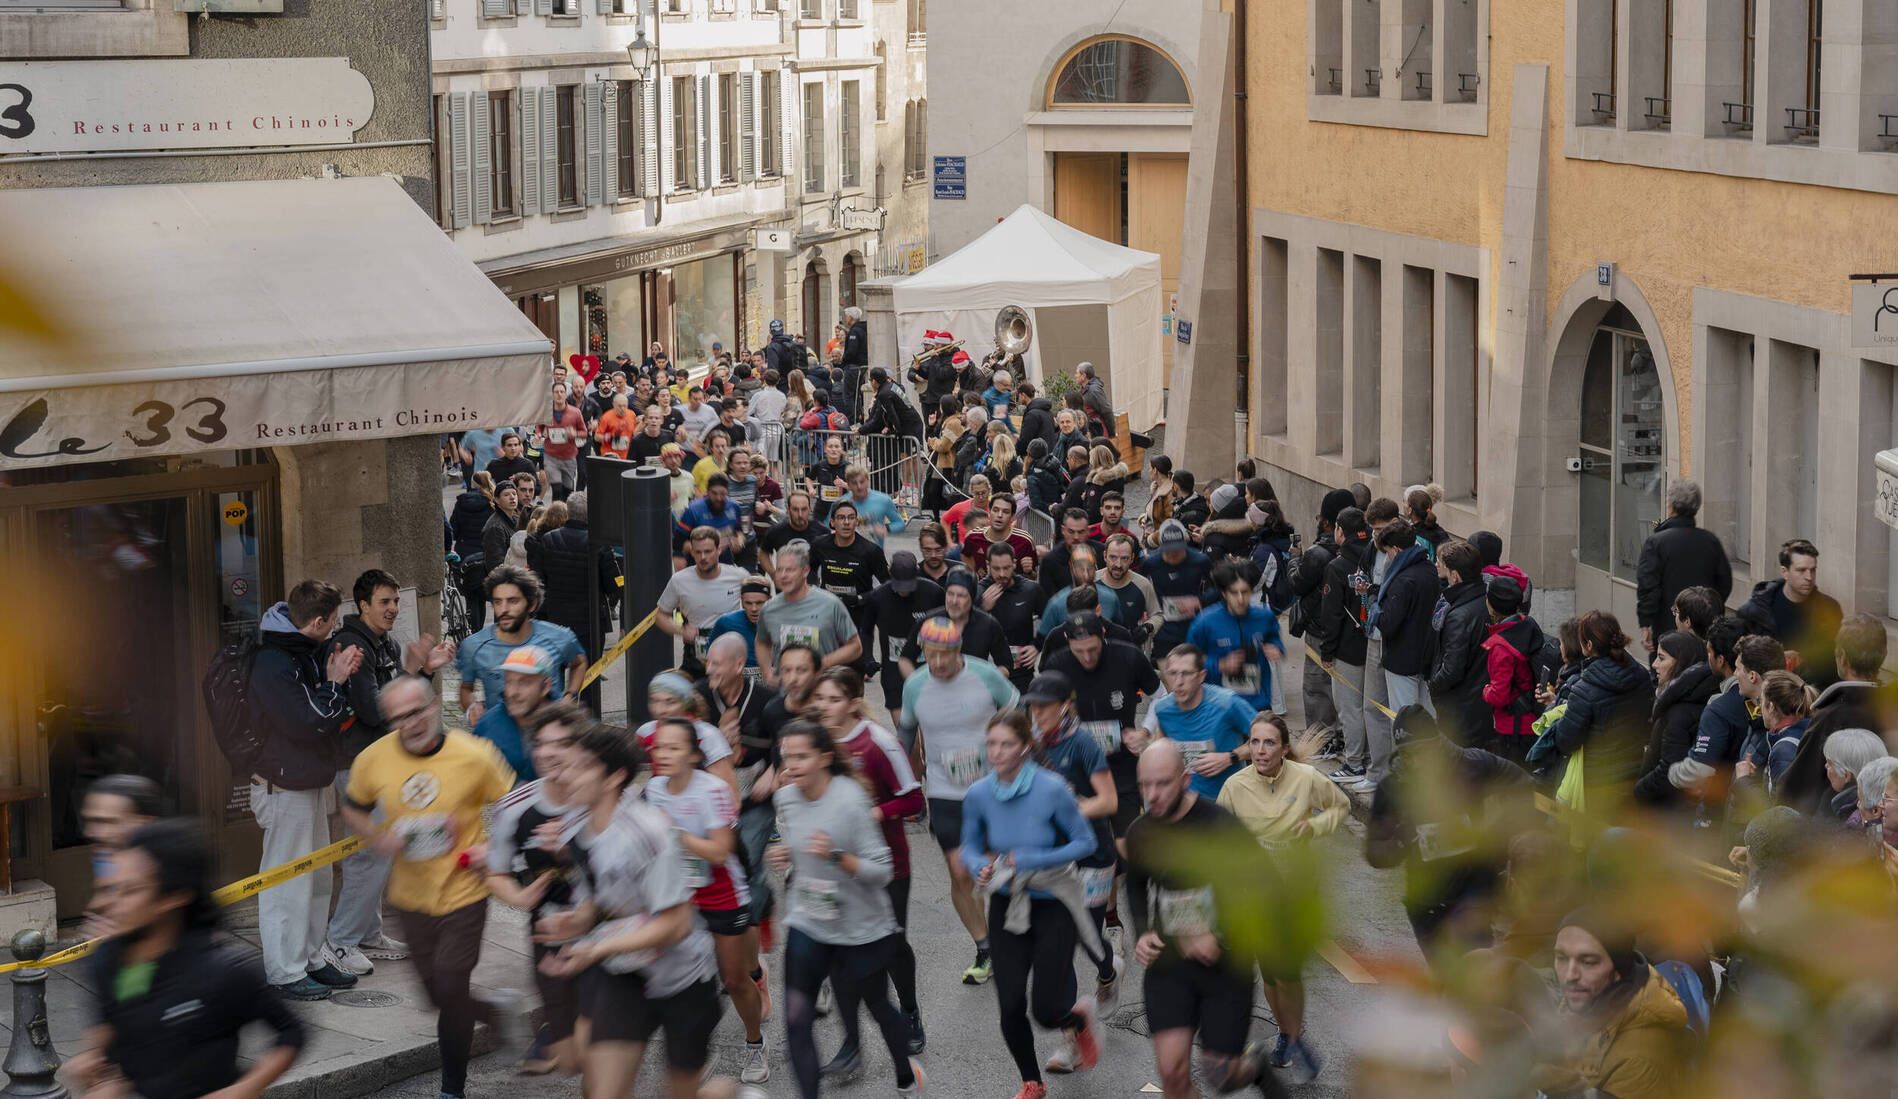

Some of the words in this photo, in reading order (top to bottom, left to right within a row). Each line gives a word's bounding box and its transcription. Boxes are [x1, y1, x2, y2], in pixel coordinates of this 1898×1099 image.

[73, 117, 234, 135] Restaurant
[252, 113, 355, 131] Chinois
[769, 233, 778, 243] G
[122, 397, 227, 447] 33
[256, 413, 383, 438] Restaurant
[396, 406, 478, 427] Chinois
[225, 509, 245, 518] POP
